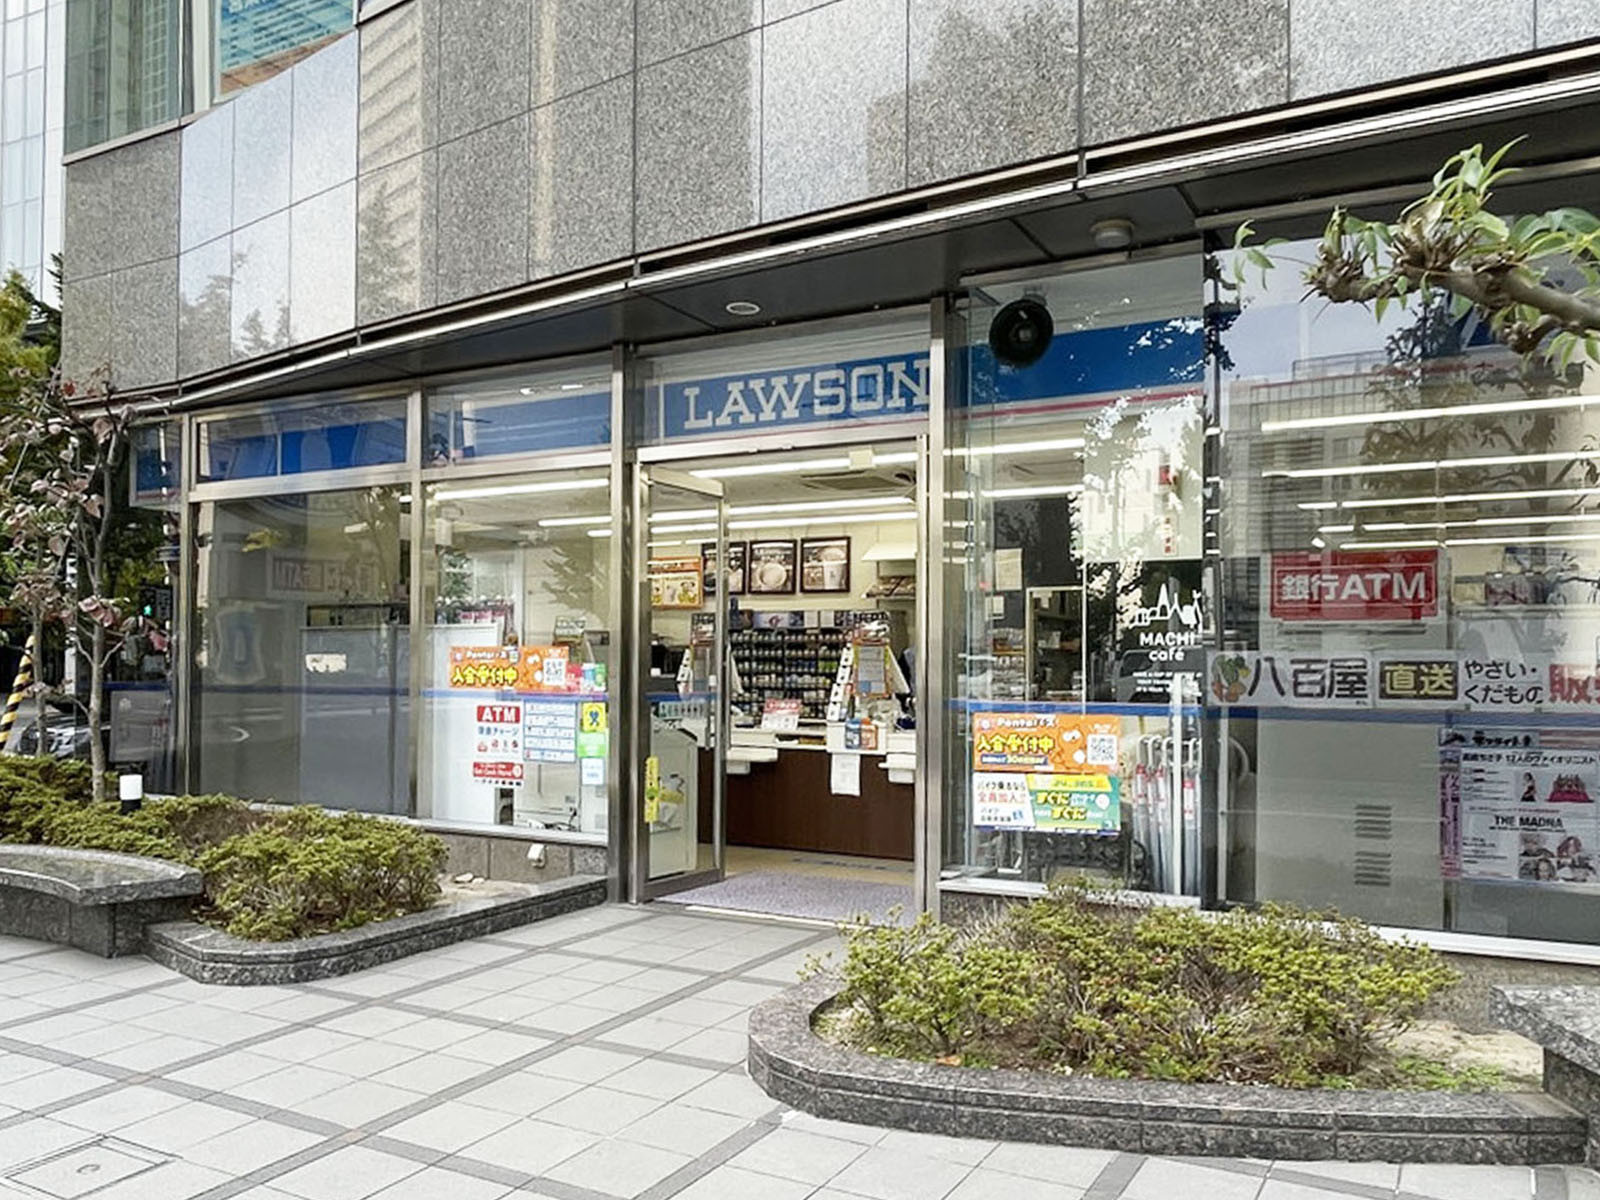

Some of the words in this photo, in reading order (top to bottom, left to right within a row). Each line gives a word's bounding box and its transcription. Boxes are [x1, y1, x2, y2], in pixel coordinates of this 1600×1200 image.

[684, 359, 930, 429] LAWSON
[1281, 572, 1426, 601] 銀行ATM
[1140, 632, 1195, 646] MACHI
[1149, 647, 1184, 661] café
[1248, 656, 1369, 699] 八百屋
[1384, 663, 1455, 696] 直送
[1549, 664, 1600, 704] 販
[1464, 684, 1543, 704] くだもの
[482, 706, 516, 722] ATM
